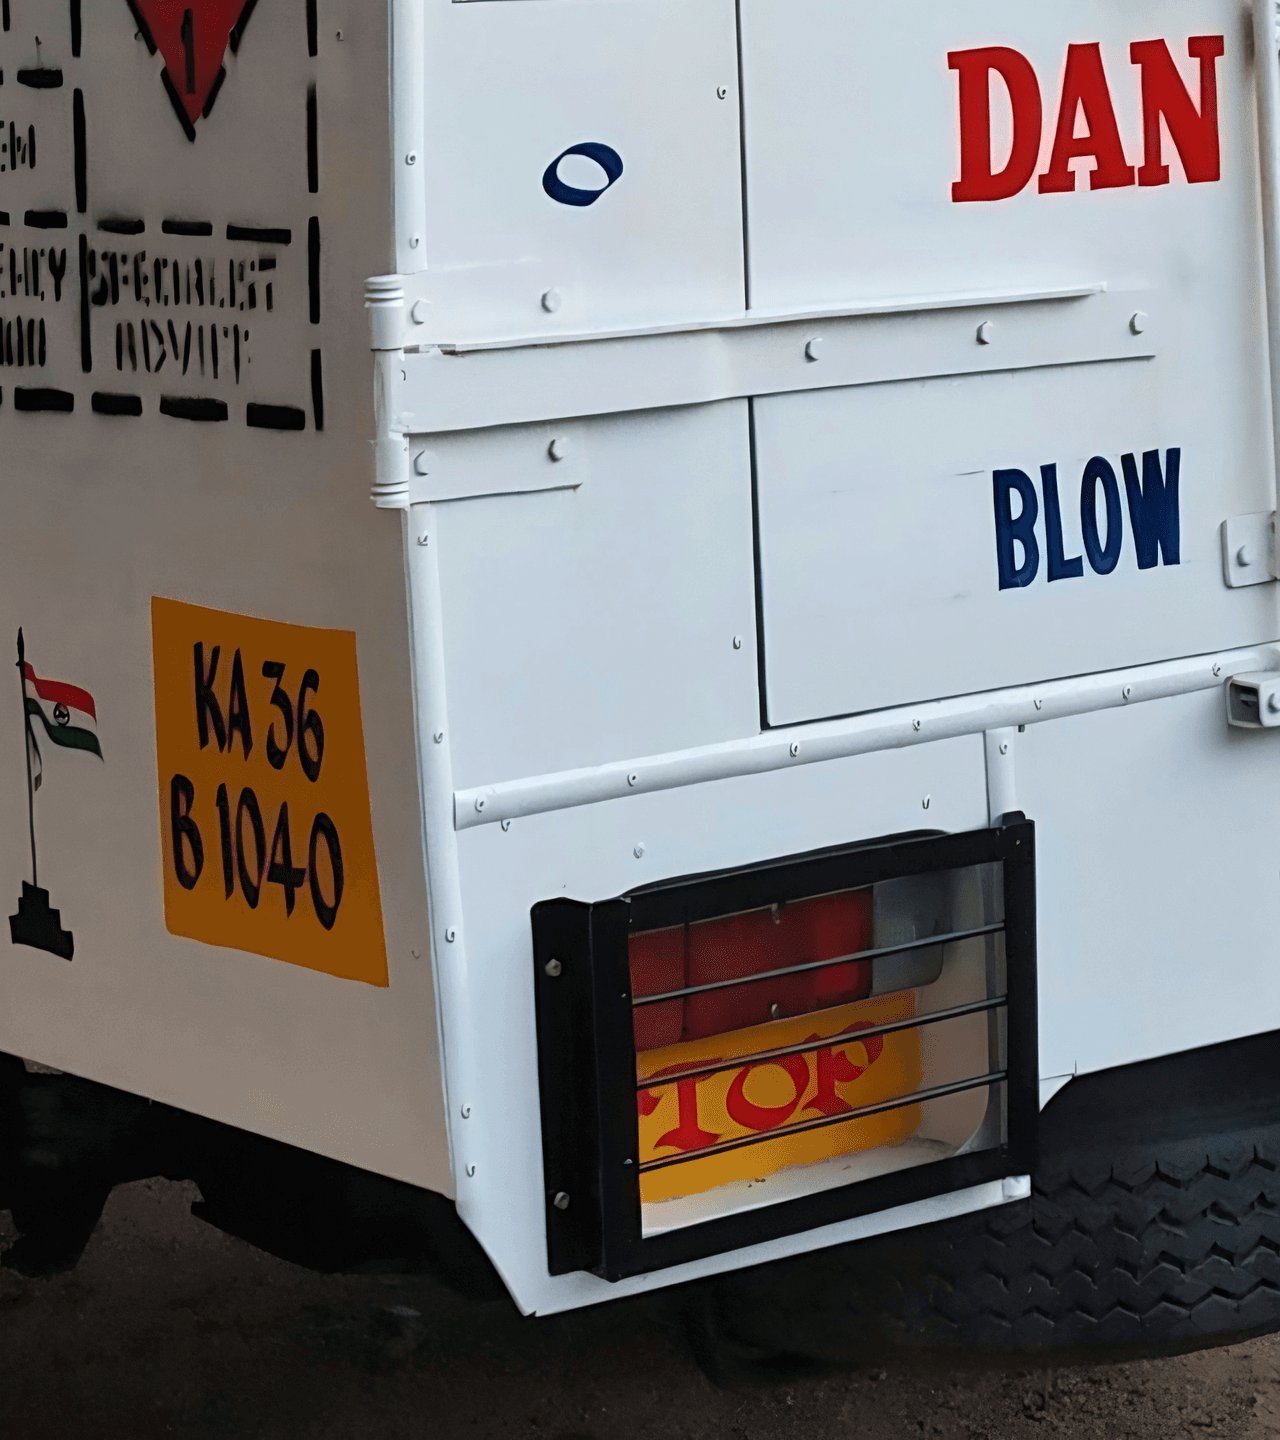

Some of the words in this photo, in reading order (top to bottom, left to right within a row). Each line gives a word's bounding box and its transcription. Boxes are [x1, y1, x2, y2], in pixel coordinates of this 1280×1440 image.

[947, 35, 1224, 203] DAN
[992, 447, 1181, 591] BLOW
[193, 641, 254, 761] KA
[262, 660, 325, 783] 36
[171, 773, 205, 891] B
[215, 783, 345, 932] 1040
